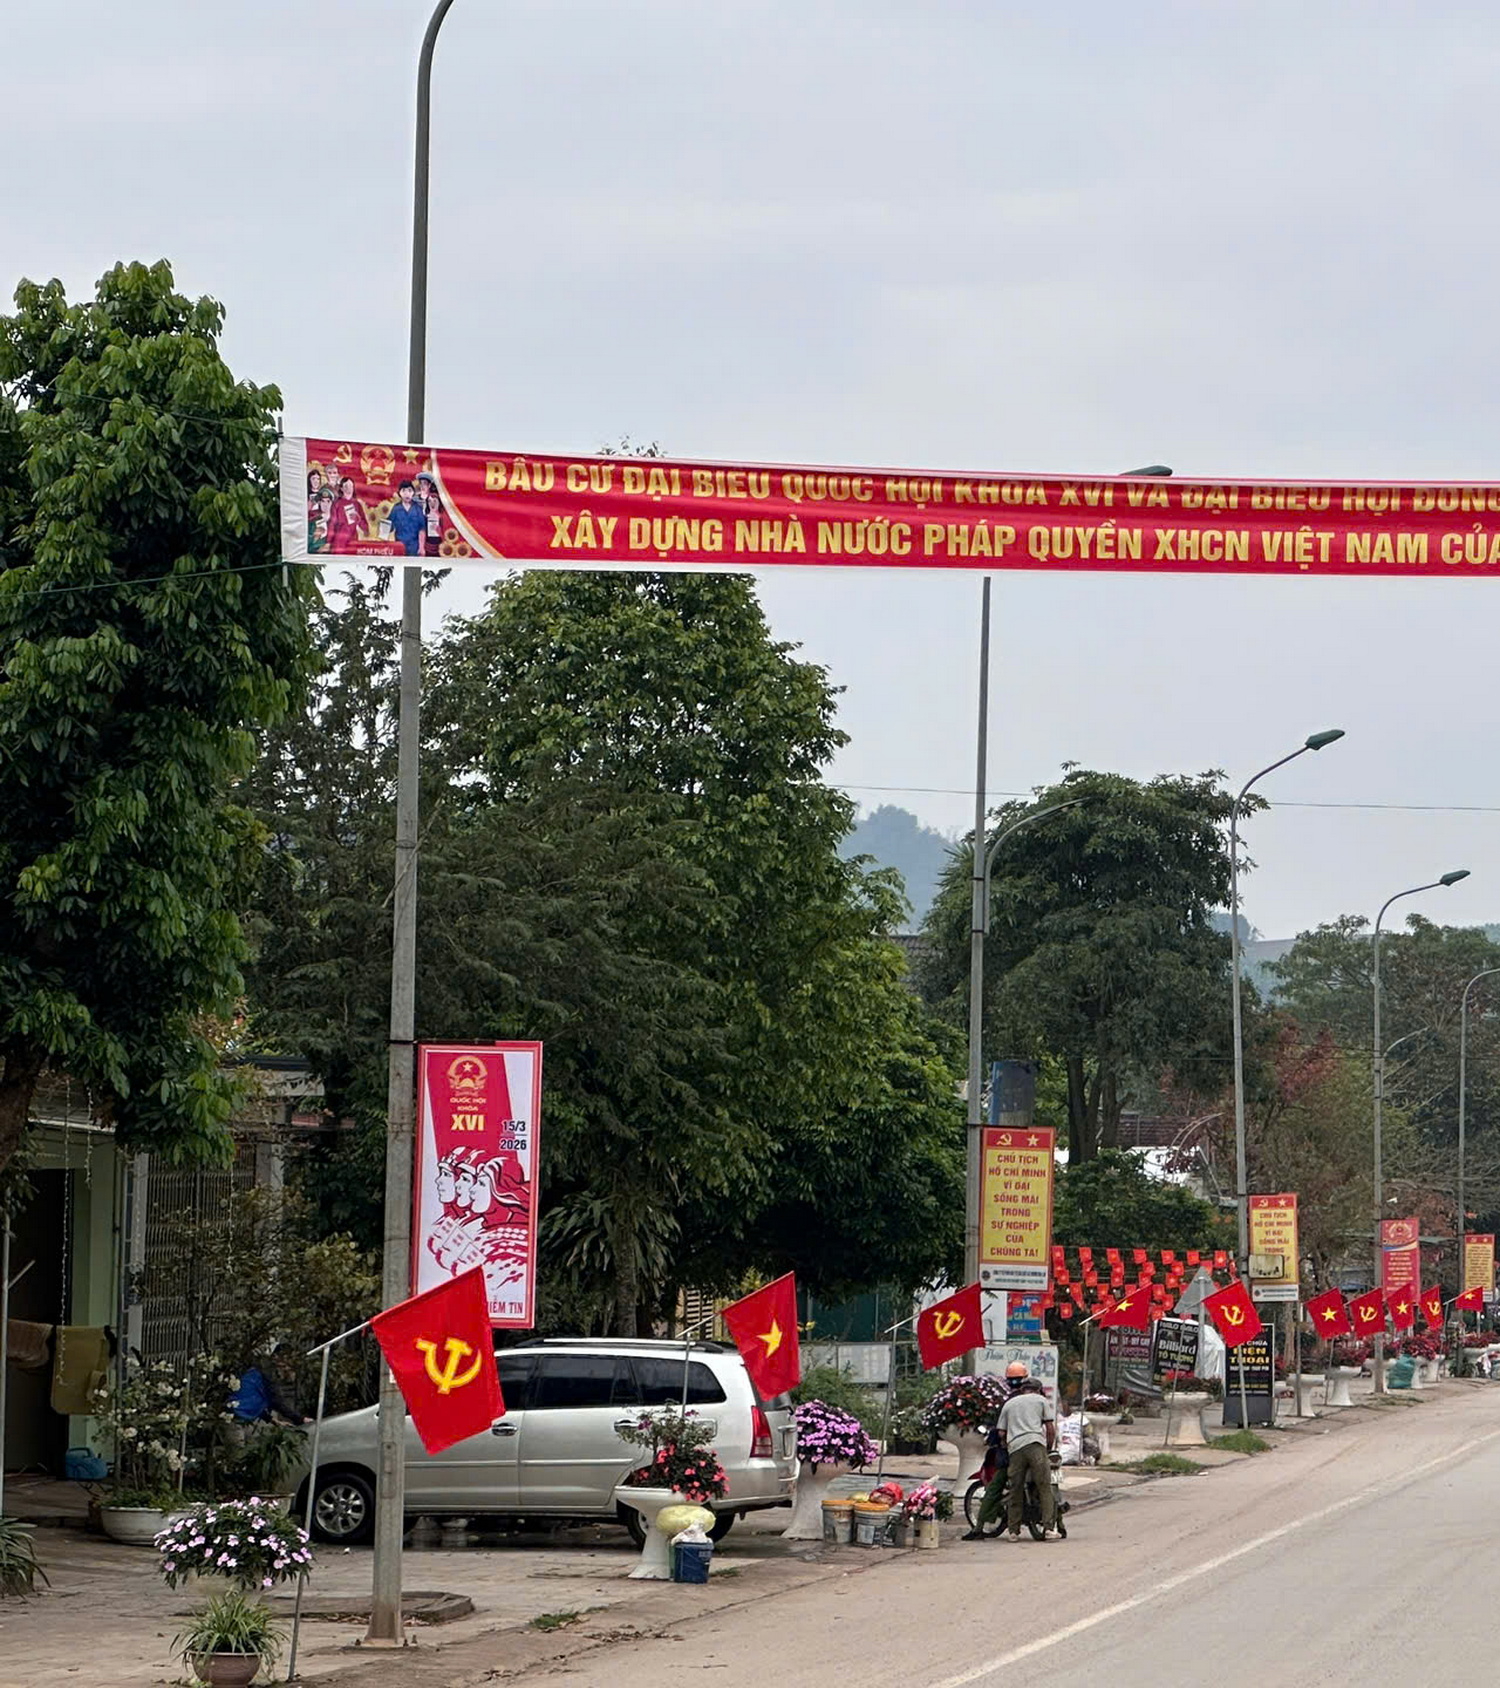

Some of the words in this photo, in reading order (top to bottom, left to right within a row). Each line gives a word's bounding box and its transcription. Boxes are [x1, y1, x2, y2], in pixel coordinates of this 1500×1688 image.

[622, 466, 681, 502] ĐẠI
[1059, 481, 1114, 508] XVI
[550, 510, 619, 549] XÂY
[629, 517, 723, 557] DỰNG
[735, 514, 806, 553] NHÀ
[818, 516, 912, 555] NƯỚC
[923, 519, 1016, 558] PHÁP
[1028, 518, 1141, 562] QUYỀN
[1153, 528, 1250, 562] XHCN
[1261, 526, 1336, 570] VIỆT
[1346, 532, 1428, 564] NAM
[451, 1113, 485, 1131] XVI
[502, 1120, 526, 1132] 15/3
[500, 1139, 527, 1150] 2026
[1001, 1207, 1031, 1218] TRONG
[509, 1302, 523, 1314] TIN
